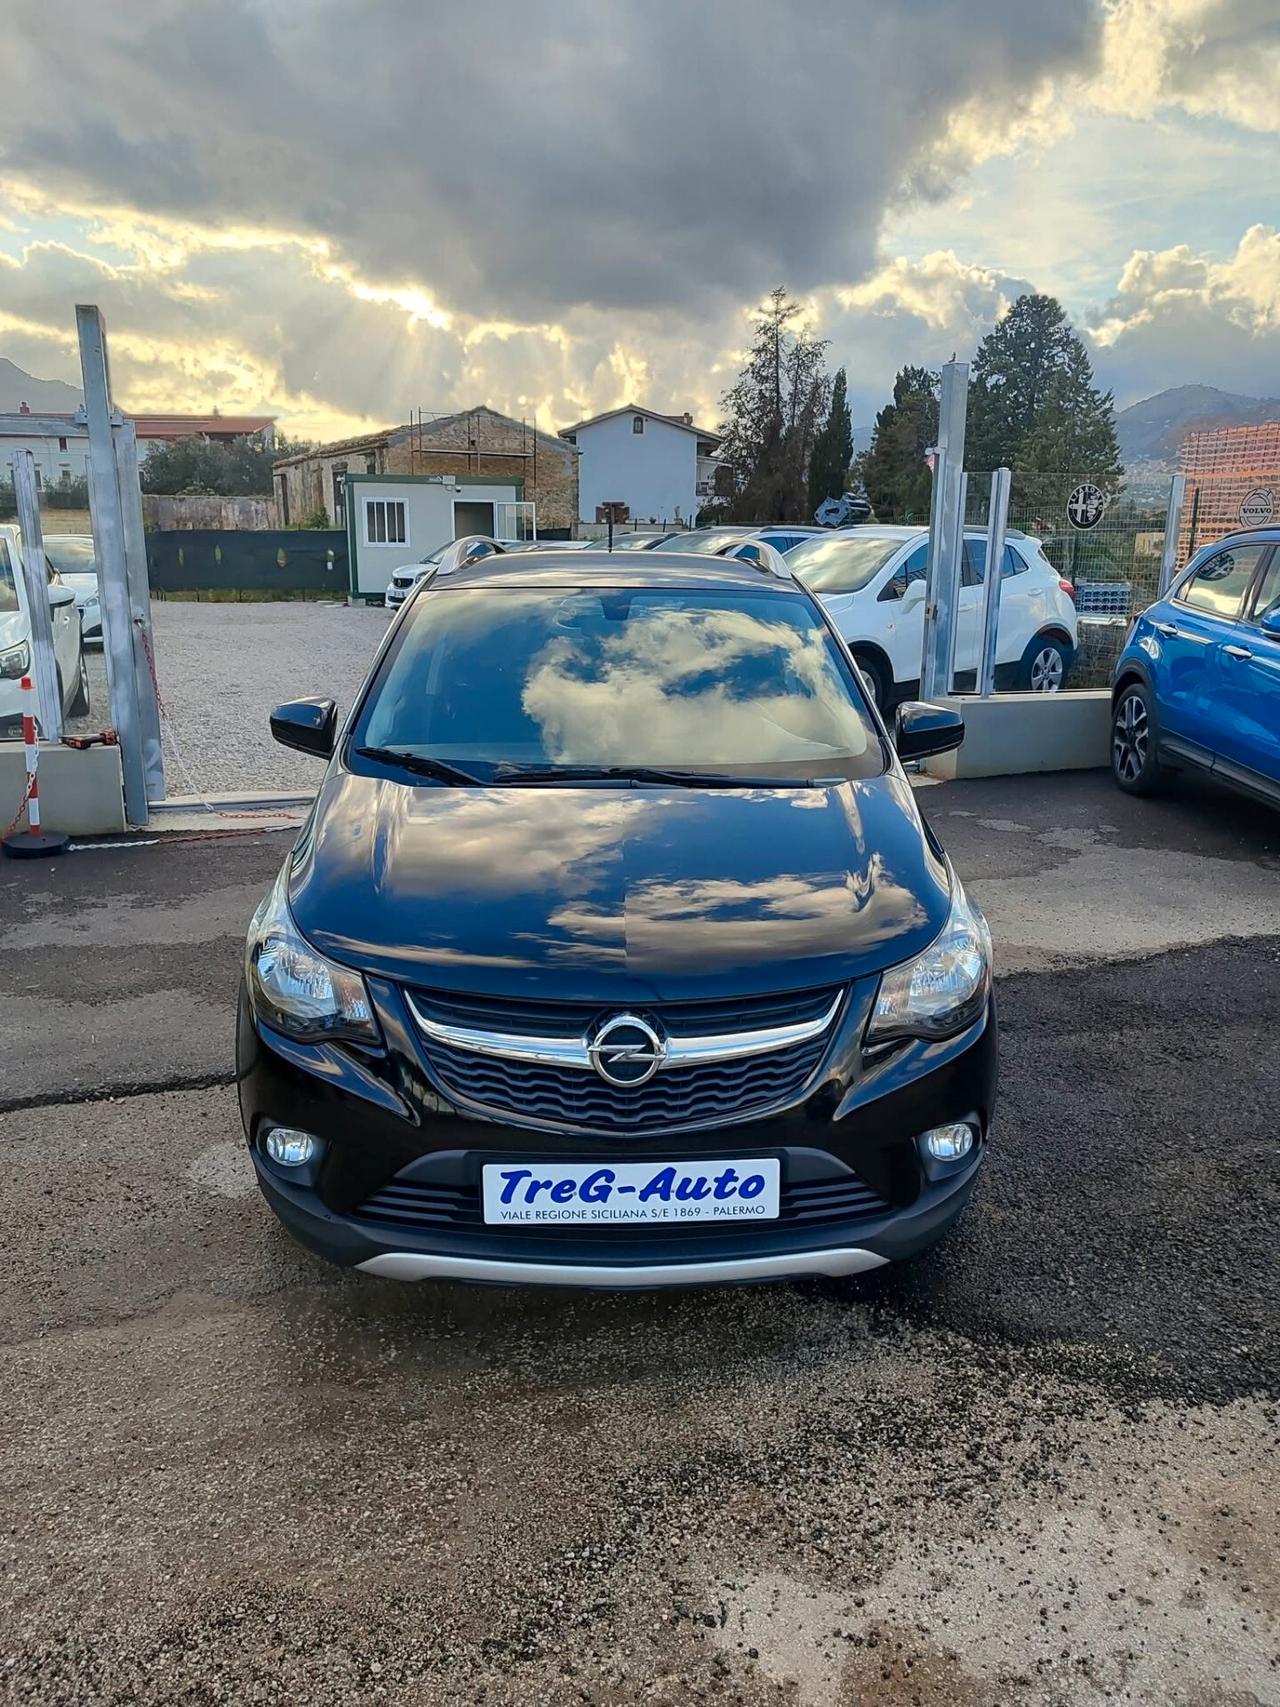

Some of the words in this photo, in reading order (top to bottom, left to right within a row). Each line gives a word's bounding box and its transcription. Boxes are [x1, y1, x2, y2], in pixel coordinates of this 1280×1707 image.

[500, 1167, 765, 1204] TreG-Auto
[500, 1210, 531, 1220] VIALE
[535, 1209, 587, 1220] REGIONE
[591, 1208, 648, 1219] SICILIANA
[651, 1208, 669, 1218] S/E
[674, 1207, 701, 1217] 1869
[713, 1205, 766, 1216] PALERMO
